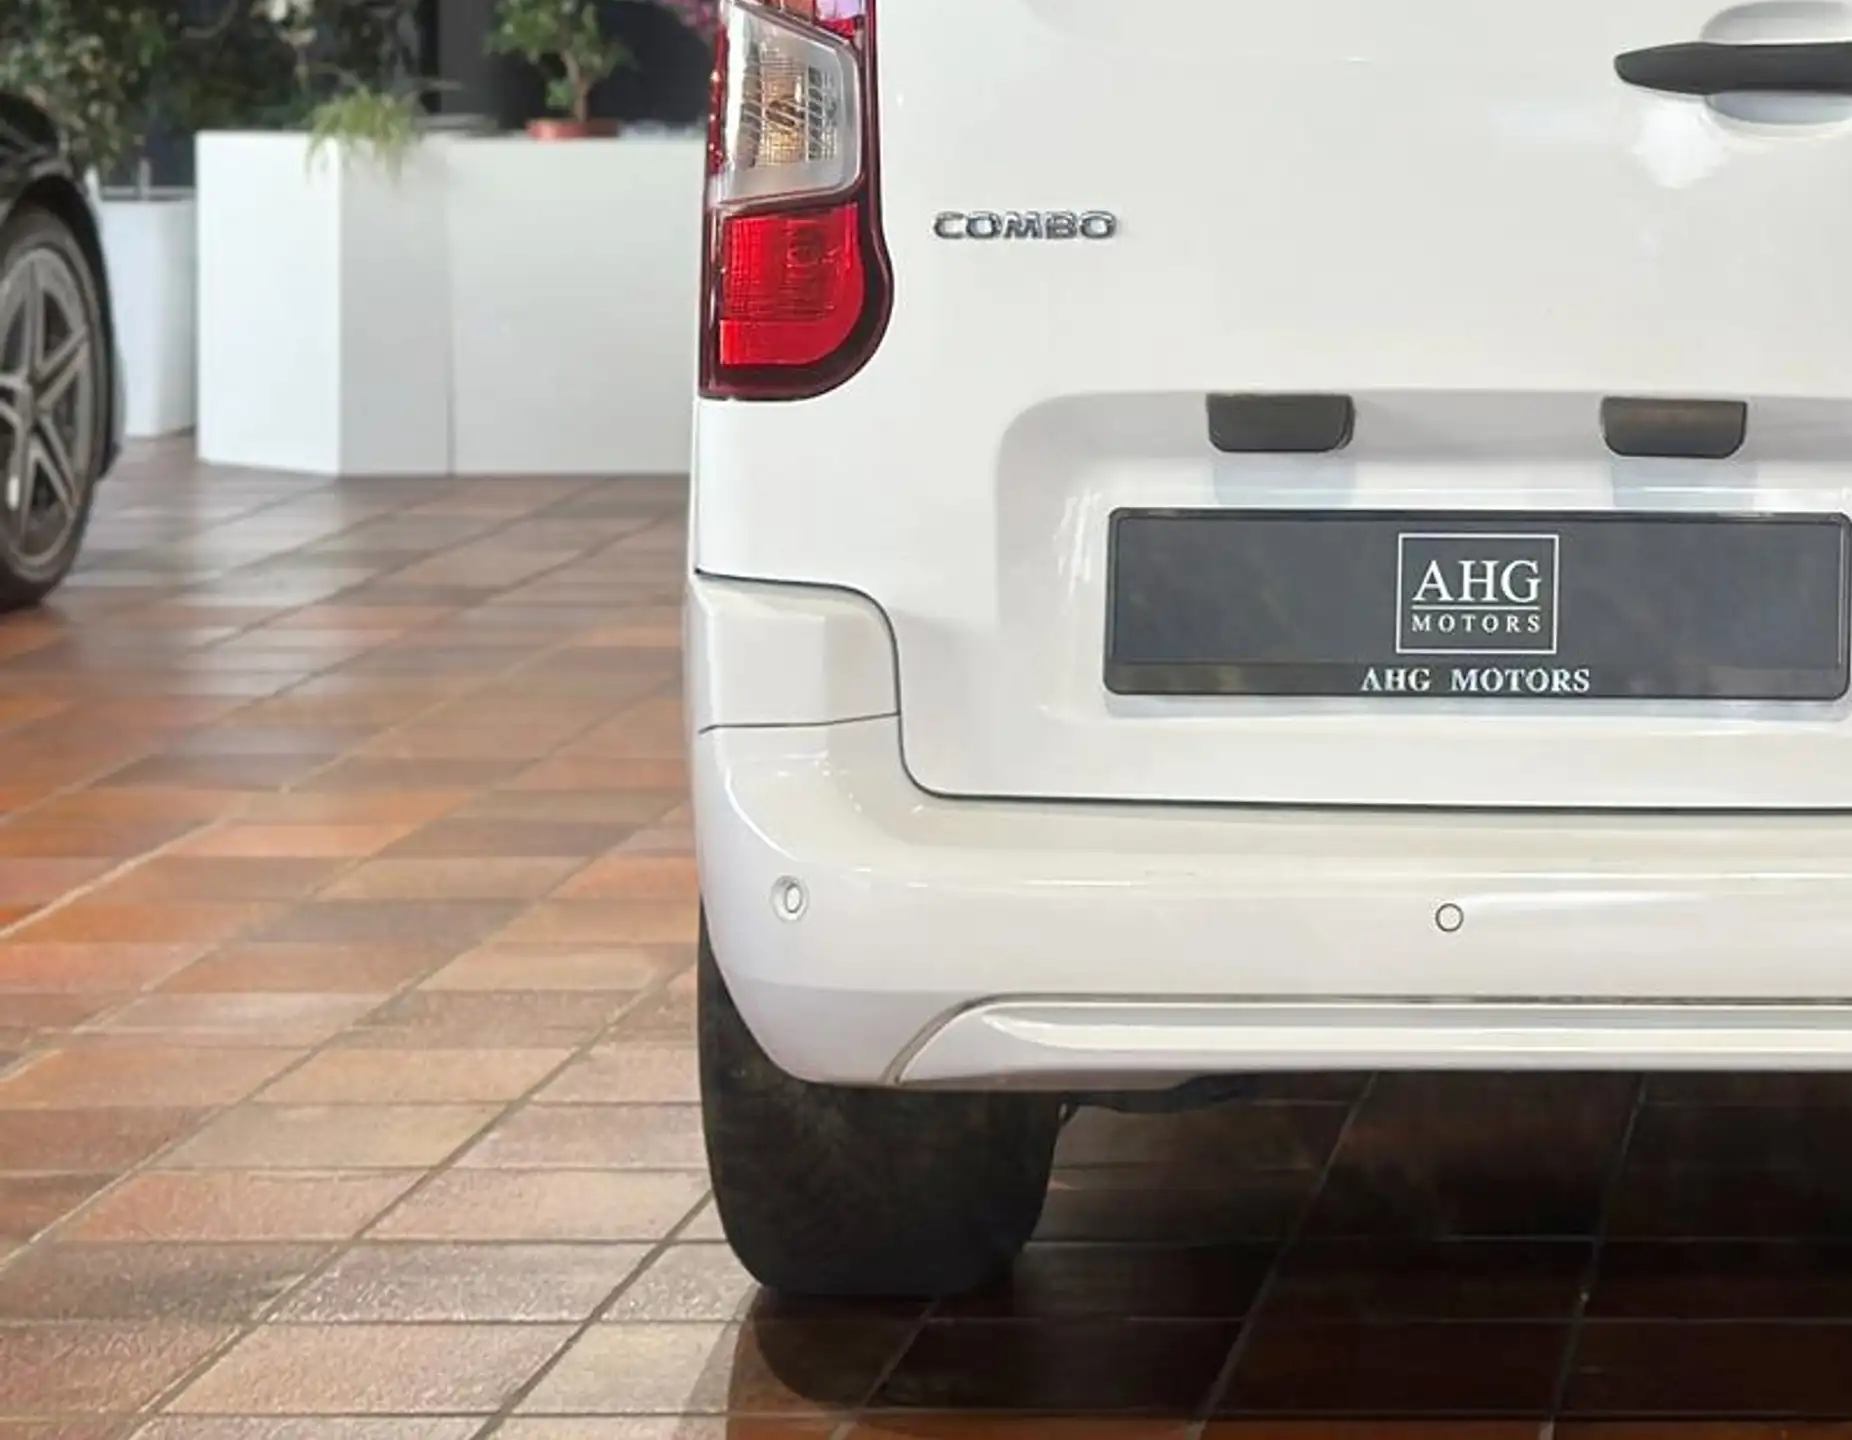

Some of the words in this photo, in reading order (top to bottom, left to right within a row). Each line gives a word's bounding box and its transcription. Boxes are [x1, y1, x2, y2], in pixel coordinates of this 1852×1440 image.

[933, 210, 1118, 240] COMBO
[1411, 559, 1542, 603] AHG
[1411, 613, 1541, 633] MOTORS
[1361, 666, 1431, 692] AHG
[1451, 666, 1591, 693] MOTORS
